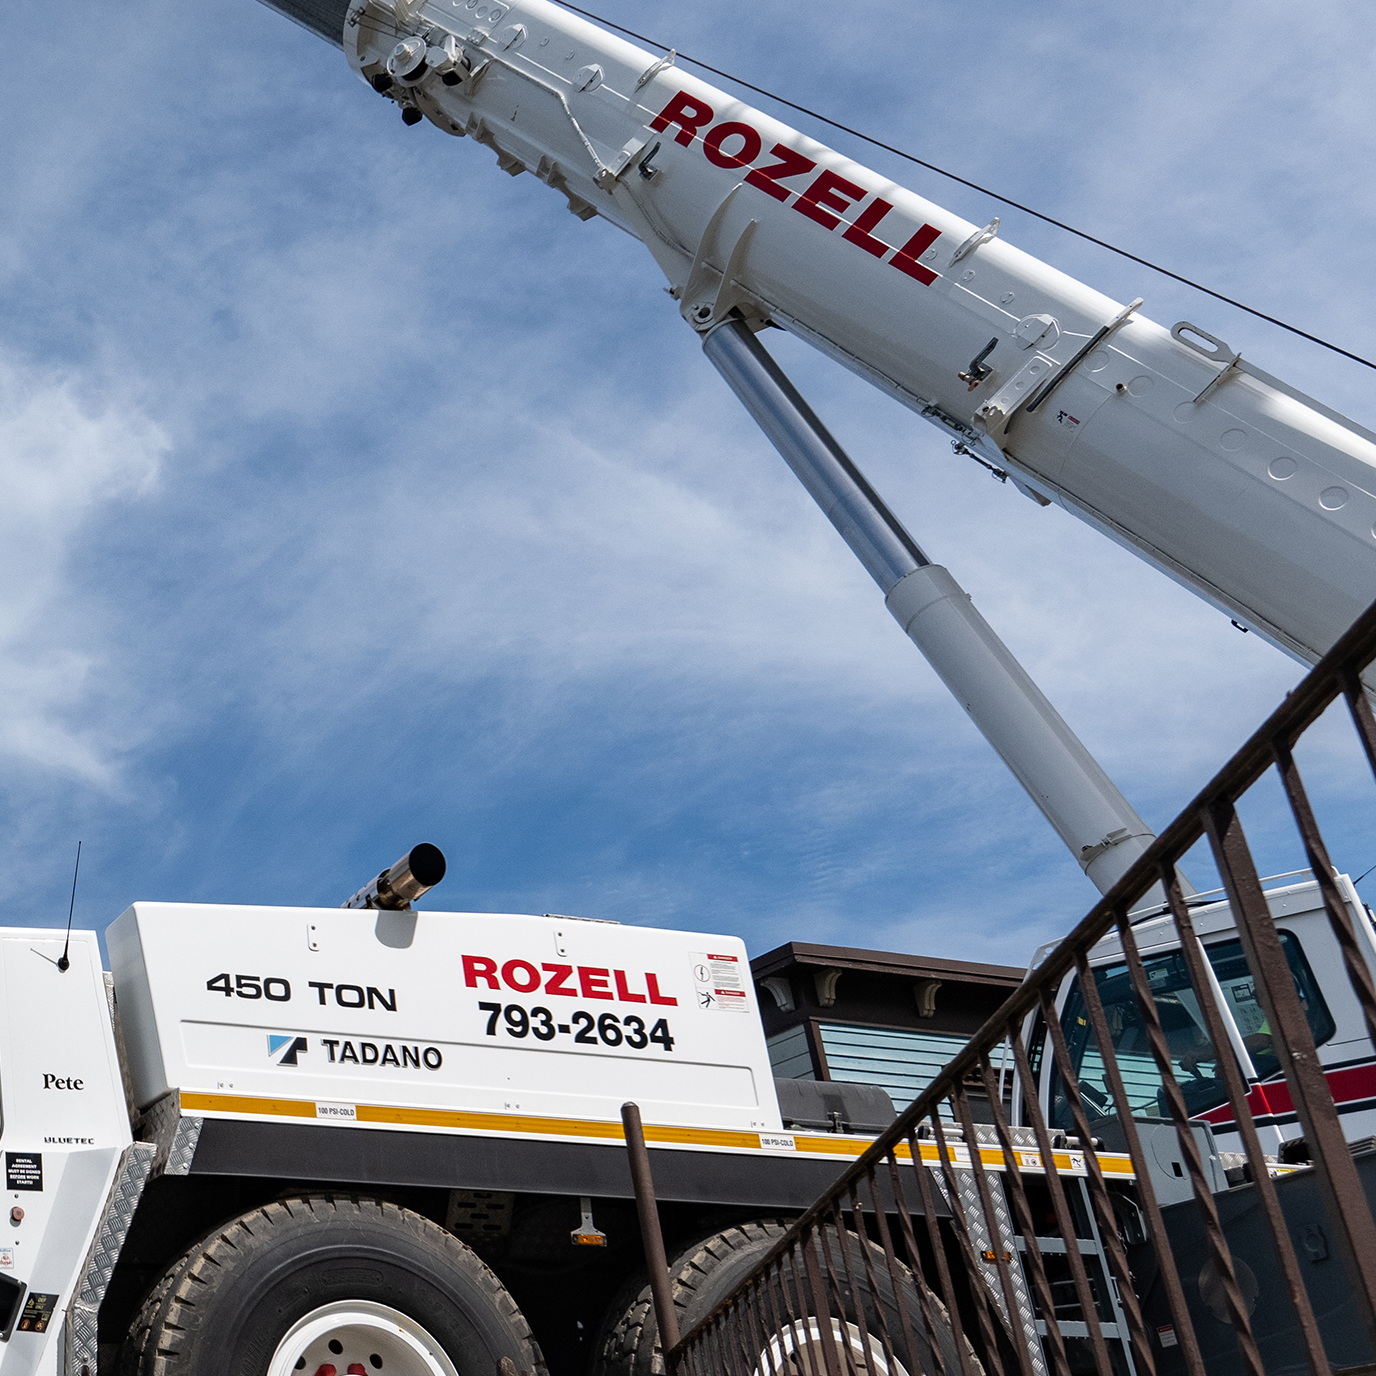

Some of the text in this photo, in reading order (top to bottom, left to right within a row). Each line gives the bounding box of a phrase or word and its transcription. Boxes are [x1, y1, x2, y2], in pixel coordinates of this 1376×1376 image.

[649, 90, 942, 287] ROZELL
[206, 973, 397, 1012] 450 TON
[461, 954, 678, 1006] ROZELL
[478, 1001, 675, 1051] 793-2634
[321, 1038, 443, 1071] TADANO
[42, 1073, 84, 1090] Pete
[329, 1108, 354, 1116] PSI-COLD
